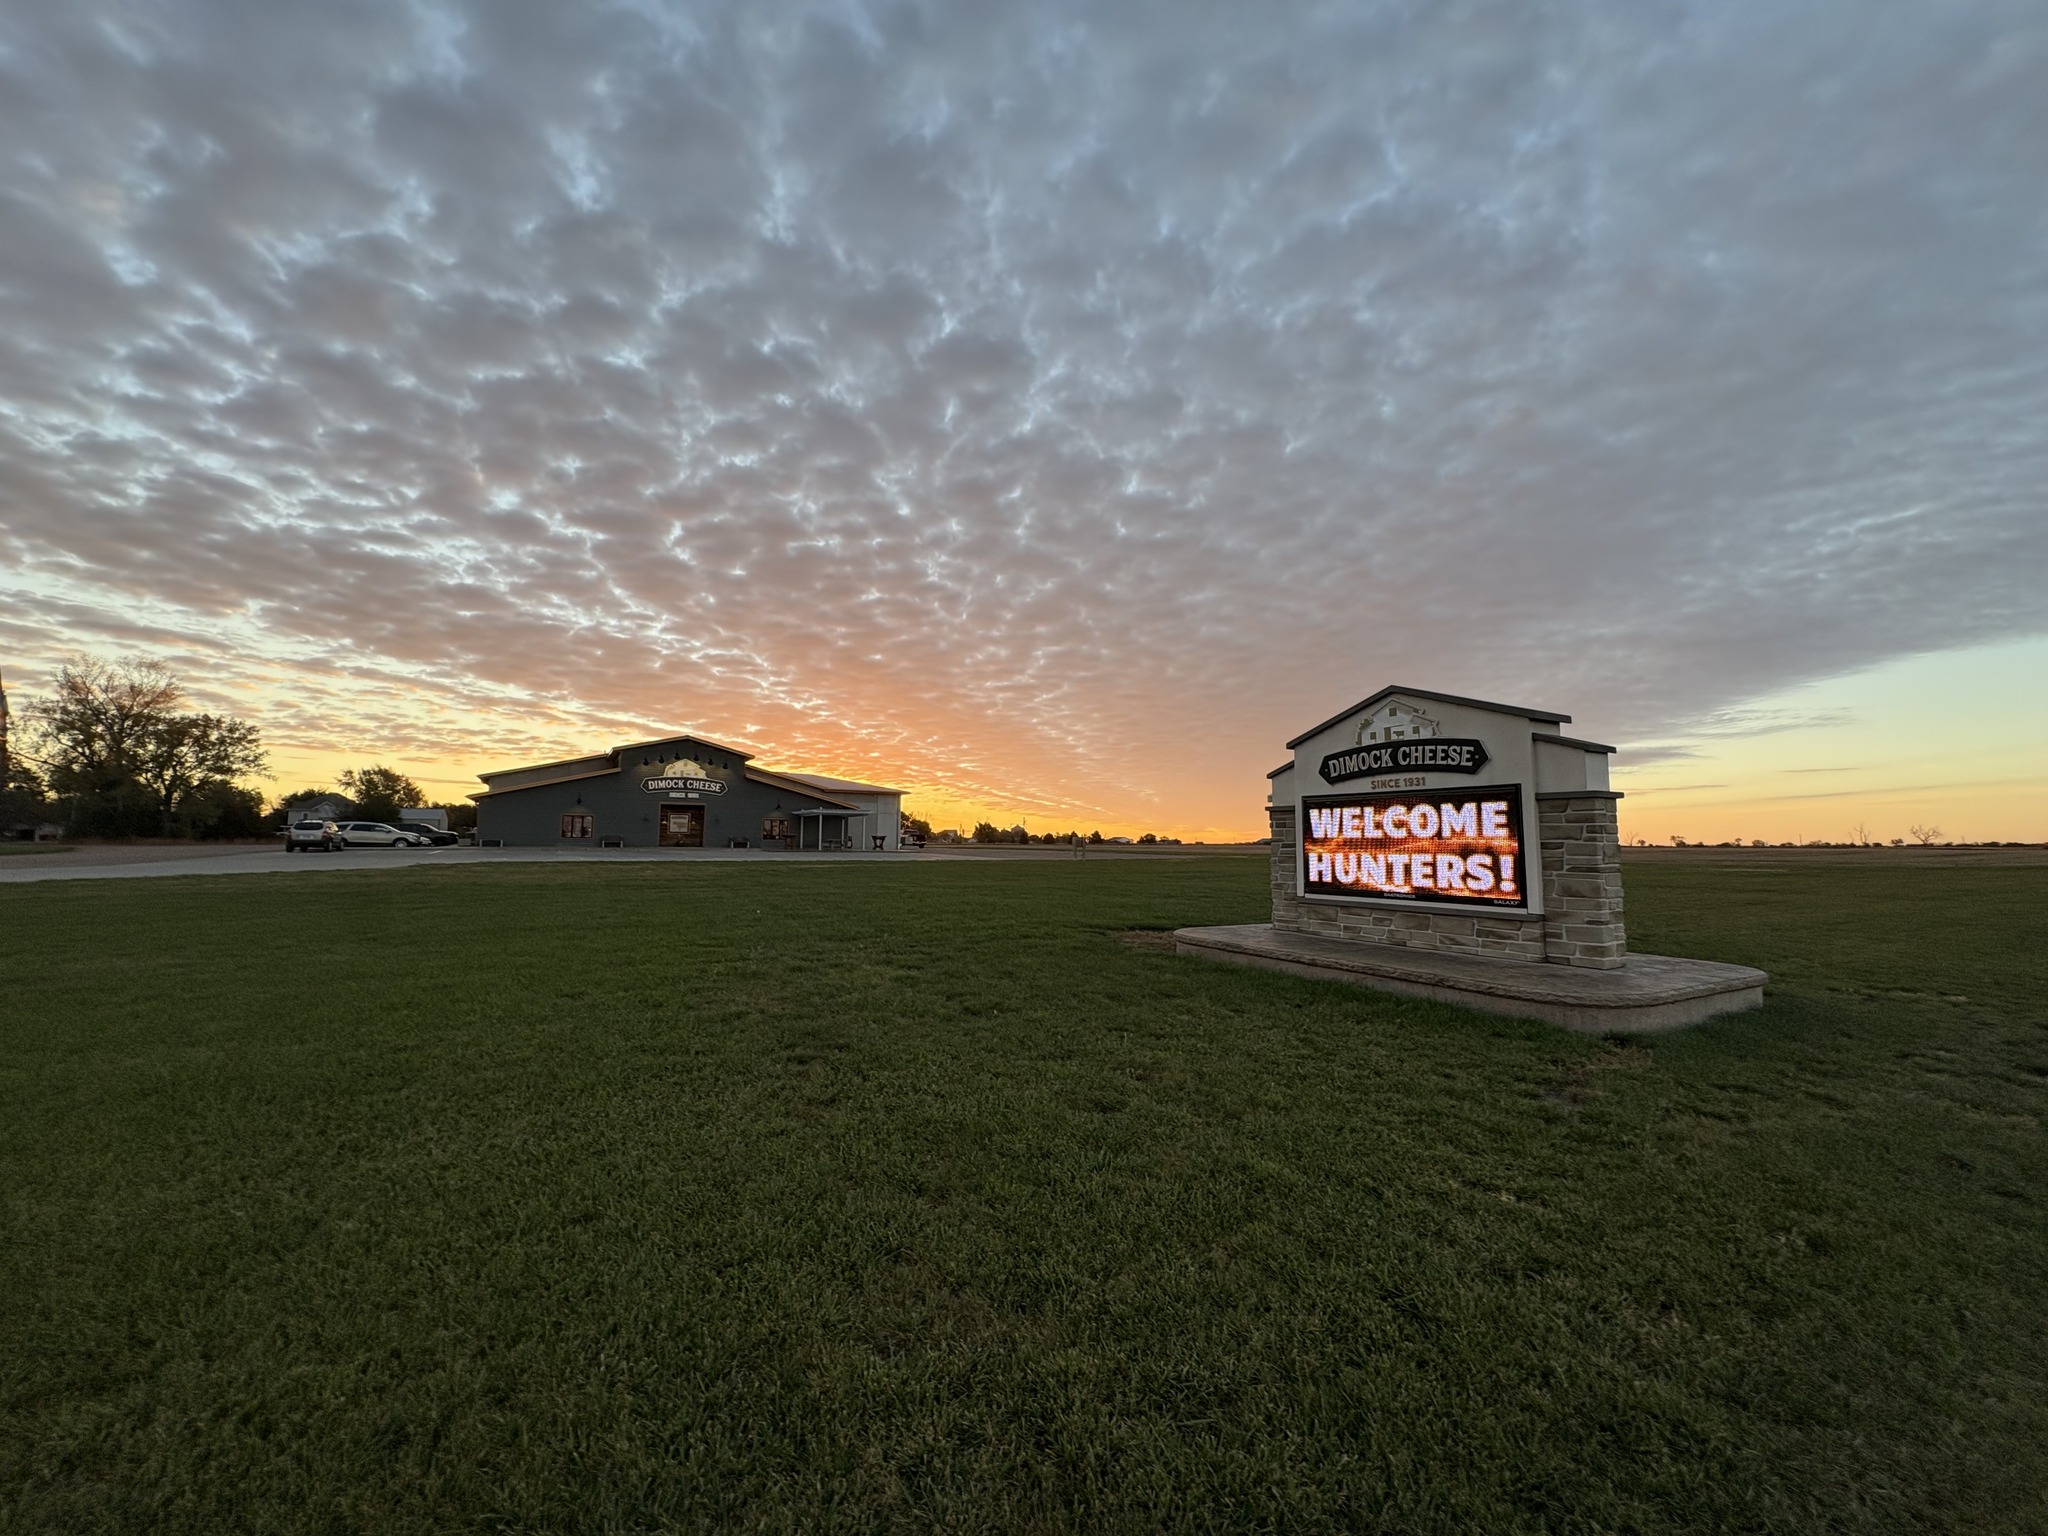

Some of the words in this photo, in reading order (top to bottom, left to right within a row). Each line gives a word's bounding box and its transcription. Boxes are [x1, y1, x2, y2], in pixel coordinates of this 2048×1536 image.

[1328, 748, 1394, 777] DIMOCK
[1398, 745, 1475, 766] CHEESE
[648, 779, 685, 790] DIMOCK
[687, 780, 722, 792] CHEESE
[1371, 778, 1401, 790] SINCE
[1403, 777, 1426, 788] 1931
[1309, 801, 1509, 838] WELCOME
[1308, 853, 1516, 892] HUNTERS!
